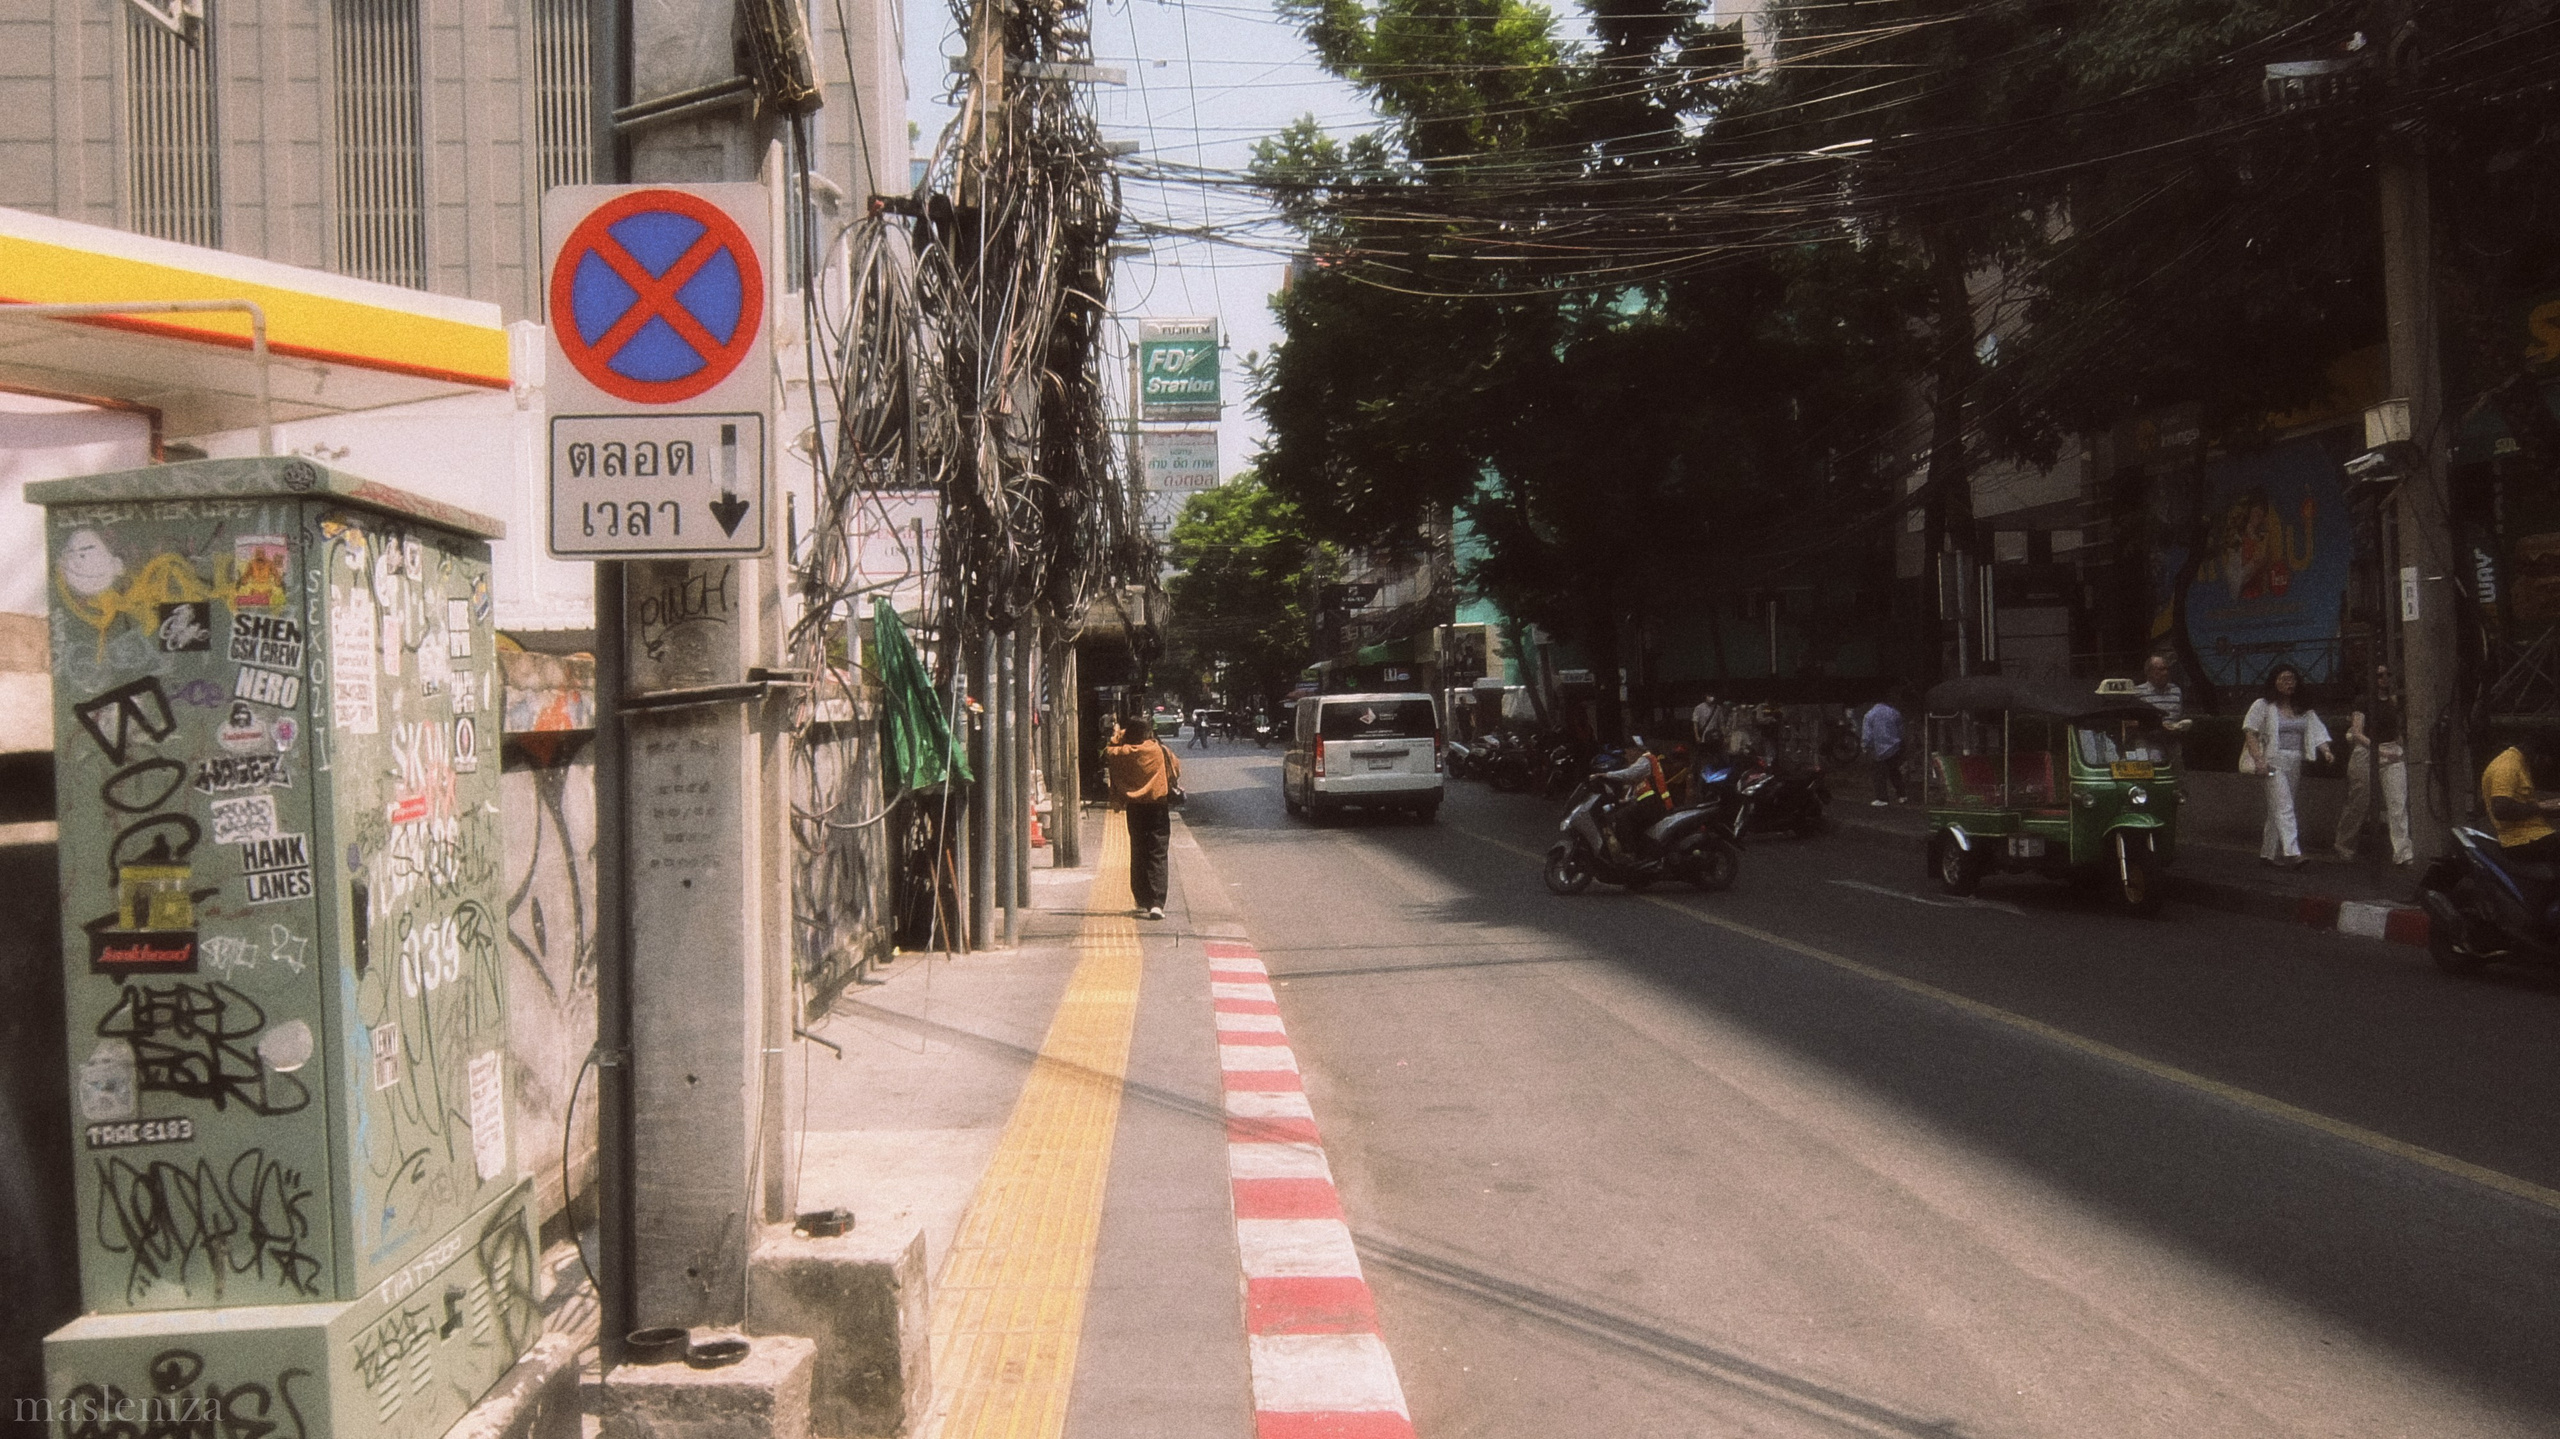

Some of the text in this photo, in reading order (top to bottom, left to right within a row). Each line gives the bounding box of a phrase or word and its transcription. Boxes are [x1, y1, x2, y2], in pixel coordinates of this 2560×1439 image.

[569, 440, 694, 478] ตลอด
[582, 501, 681, 538] เวลา
[234, 613, 302, 644] SHEN
[235, 666, 300, 709] NERO
[242, 836, 305, 870] HANK
[247, 869, 312, 902] LANES
